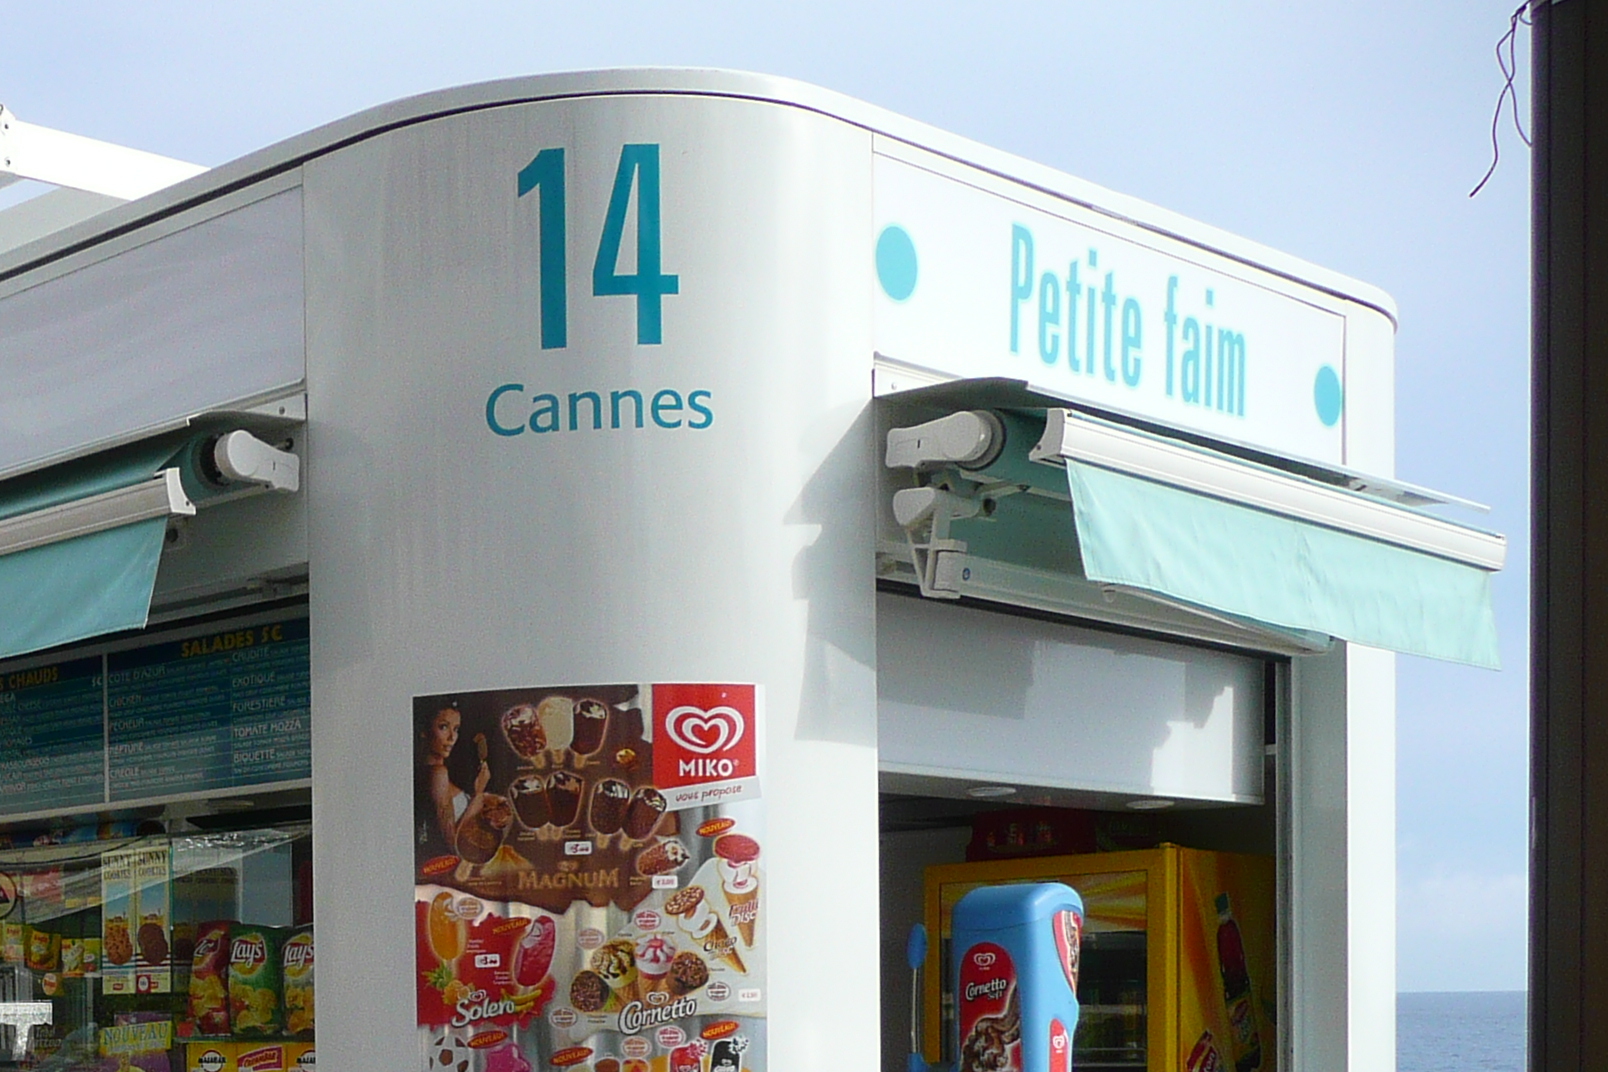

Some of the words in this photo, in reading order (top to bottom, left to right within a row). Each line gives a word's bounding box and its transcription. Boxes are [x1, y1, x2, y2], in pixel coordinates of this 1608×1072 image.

[517, 143, 679, 350] 14
[1009, 220, 1143, 387] Petite
[1163, 275, 1246, 418] faim
[485, 383, 714, 437] Cannes
[182, 631, 254, 658] SALADES
[9, 667, 59, 690] CHAUDS
[678, 758, 734, 777] MIKO
[675, 791, 699, 802] vous
[701, 785, 743, 803] propose
[518, 868, 620, 890] MAGNUM
[965, 978, 1007, 1000] Cornetto
[452, 997, 516, 1028] Solero
[618, 997, 697, 1035] Cornetto
[103, 1022, 168, 1045] NOUVEAU
